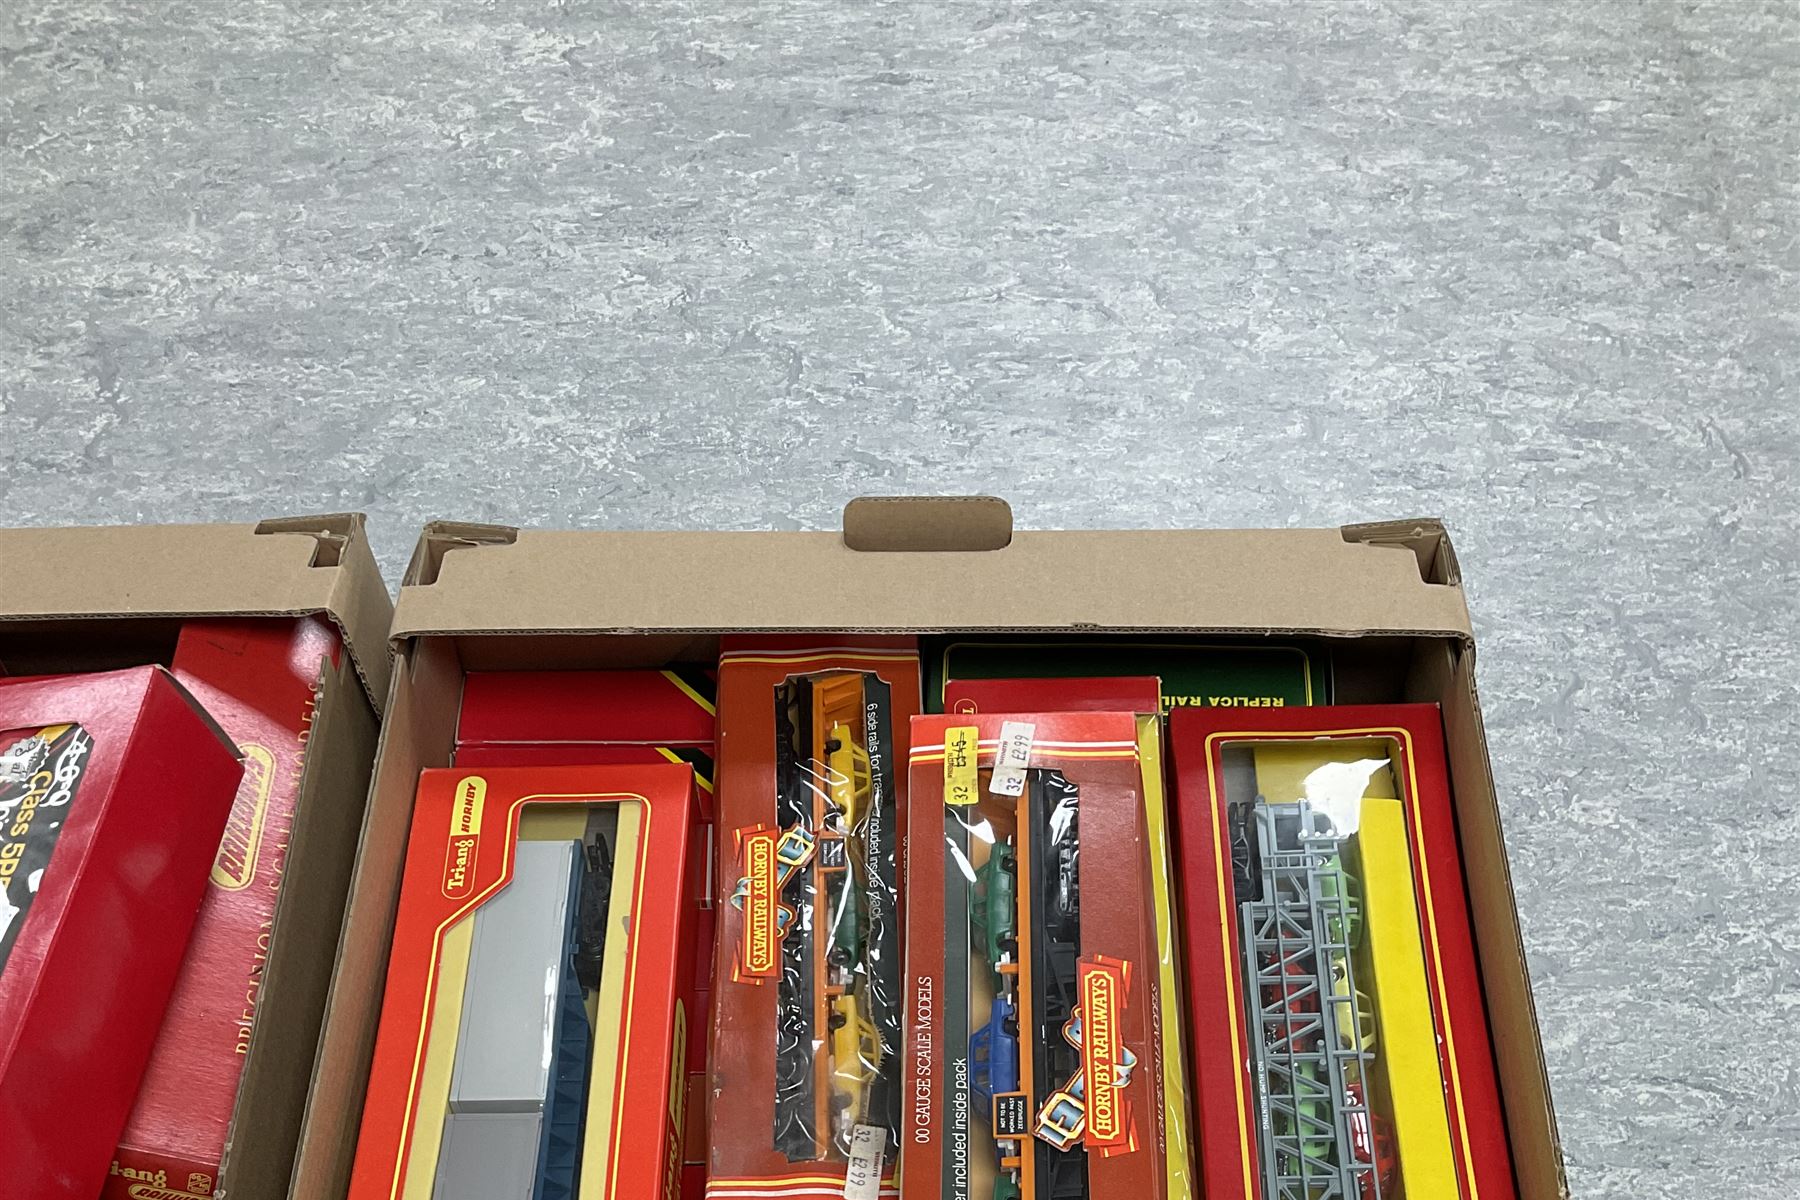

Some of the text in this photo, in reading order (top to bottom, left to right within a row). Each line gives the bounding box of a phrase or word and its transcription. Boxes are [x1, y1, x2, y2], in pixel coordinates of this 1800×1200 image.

[1162, 696, 1284, 707] REPLICA RAIL
[868, 712, 880, 731] side
[868, 732, 880, 752] rails
[870, 754, 882, 771] for
[953, 786, 968, 800] 32
[1006, 778, 1022, 792] 32
[10, 770, 53, 837] Class
[461, 782, 477, 832] HORNBY
[869, 818, 880, 854] included
[869, 856, 882, 888] inside
[752, 842, 768, 966] HORNBY RAILWAYS
[918, 976, 932, 1030] MODELS
[916, 1033, 932, 1076] SCALE
[1092, 978, 1112, 1132] HORNBY RAILWAYS
[1258, 1061, 1264, 1072] NO
[953, 1058, 968, 1090] pack
[916, 1078, 930, 1126] GAUGE
[952, 1092, 967, 1130] inside
[855, 1128, 871, 1142] 32
[110, 1160, 168, 1188] i-ang
[952, 1132, 966, 1188] included
